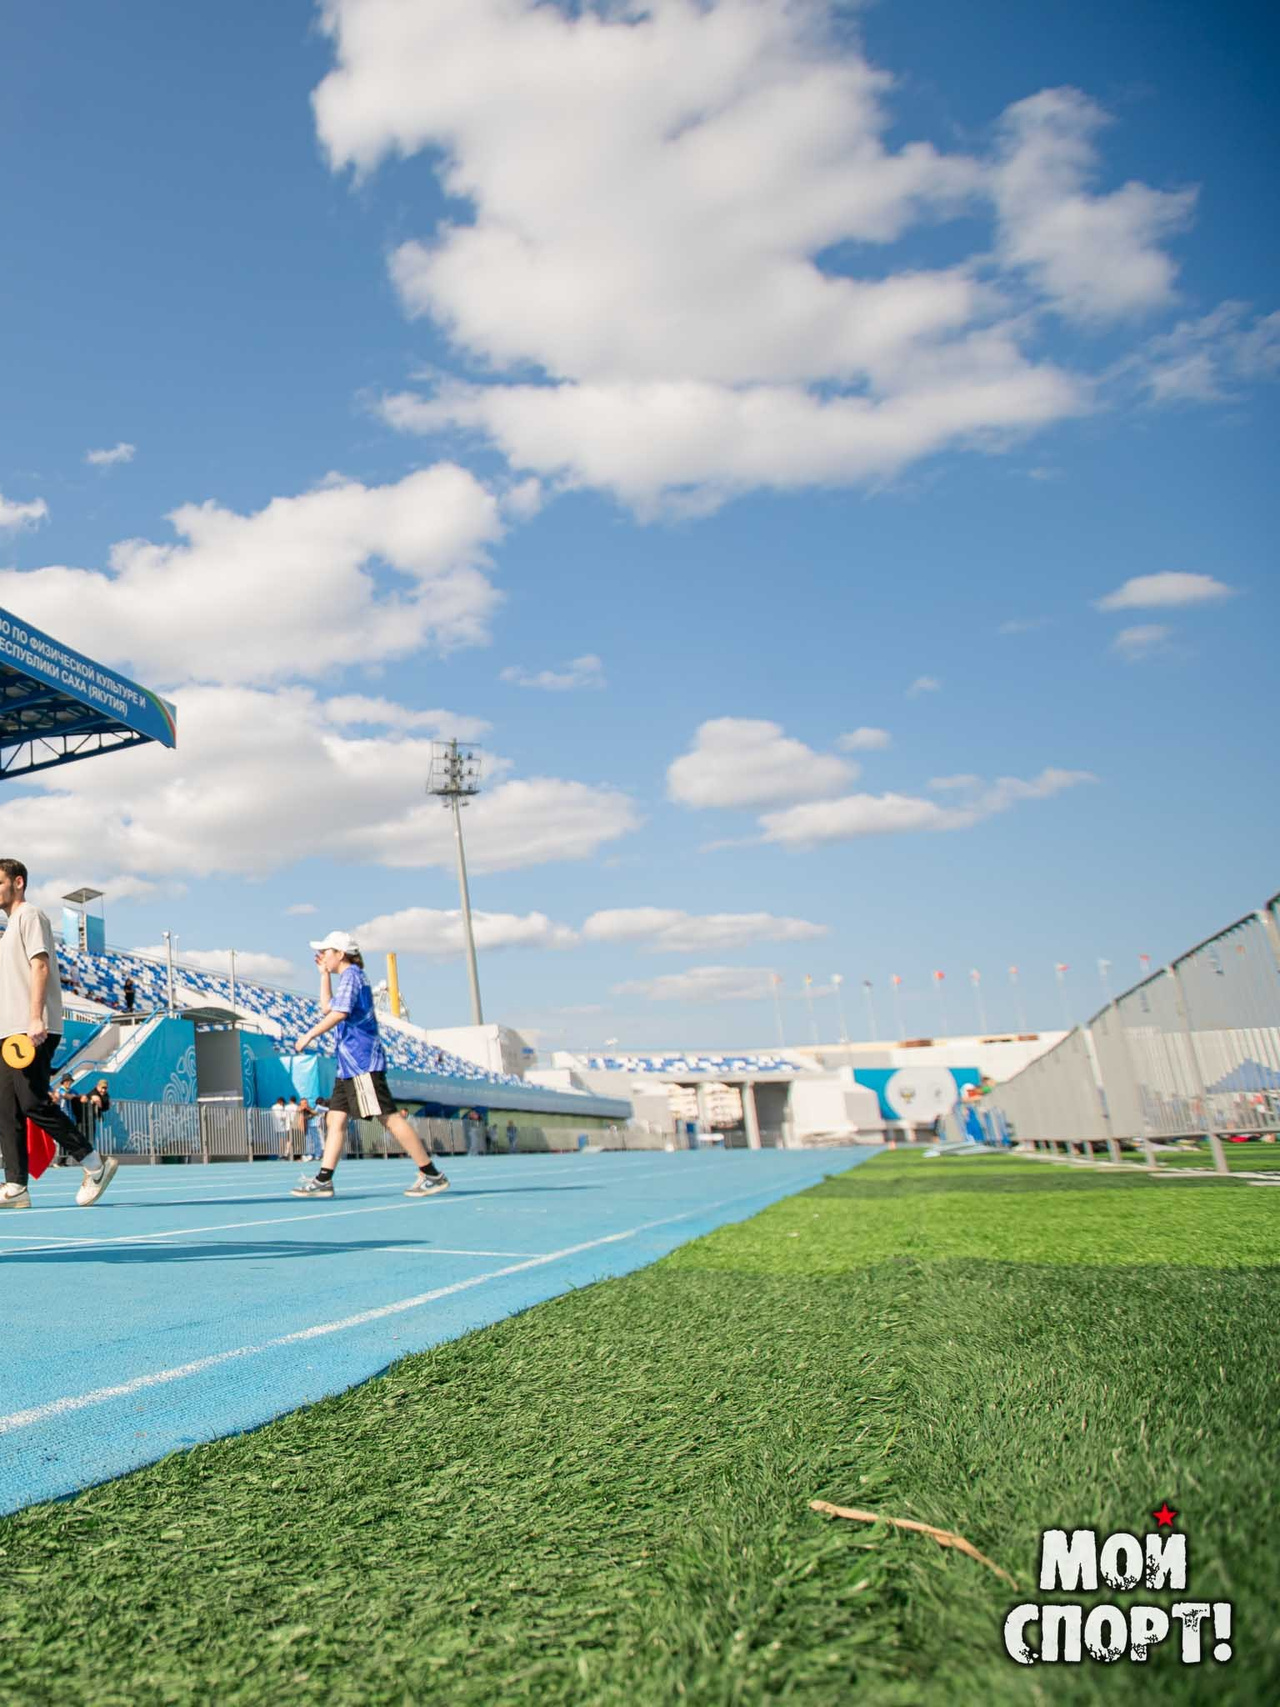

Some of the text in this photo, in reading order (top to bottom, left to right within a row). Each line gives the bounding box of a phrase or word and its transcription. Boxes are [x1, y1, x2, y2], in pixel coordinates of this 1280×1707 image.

[12, 626, 28, 645] ПО
[30, 637, 95, 681] ФИЗИЧЕСКОЙ
[96, 672, 138, 704] КУЛЬТУРЕ
[139, 696, 147, 709] И
[60, 669, 88, 694] САХА
[88, 685, 129, 718] (ЯКУТИЯ)
